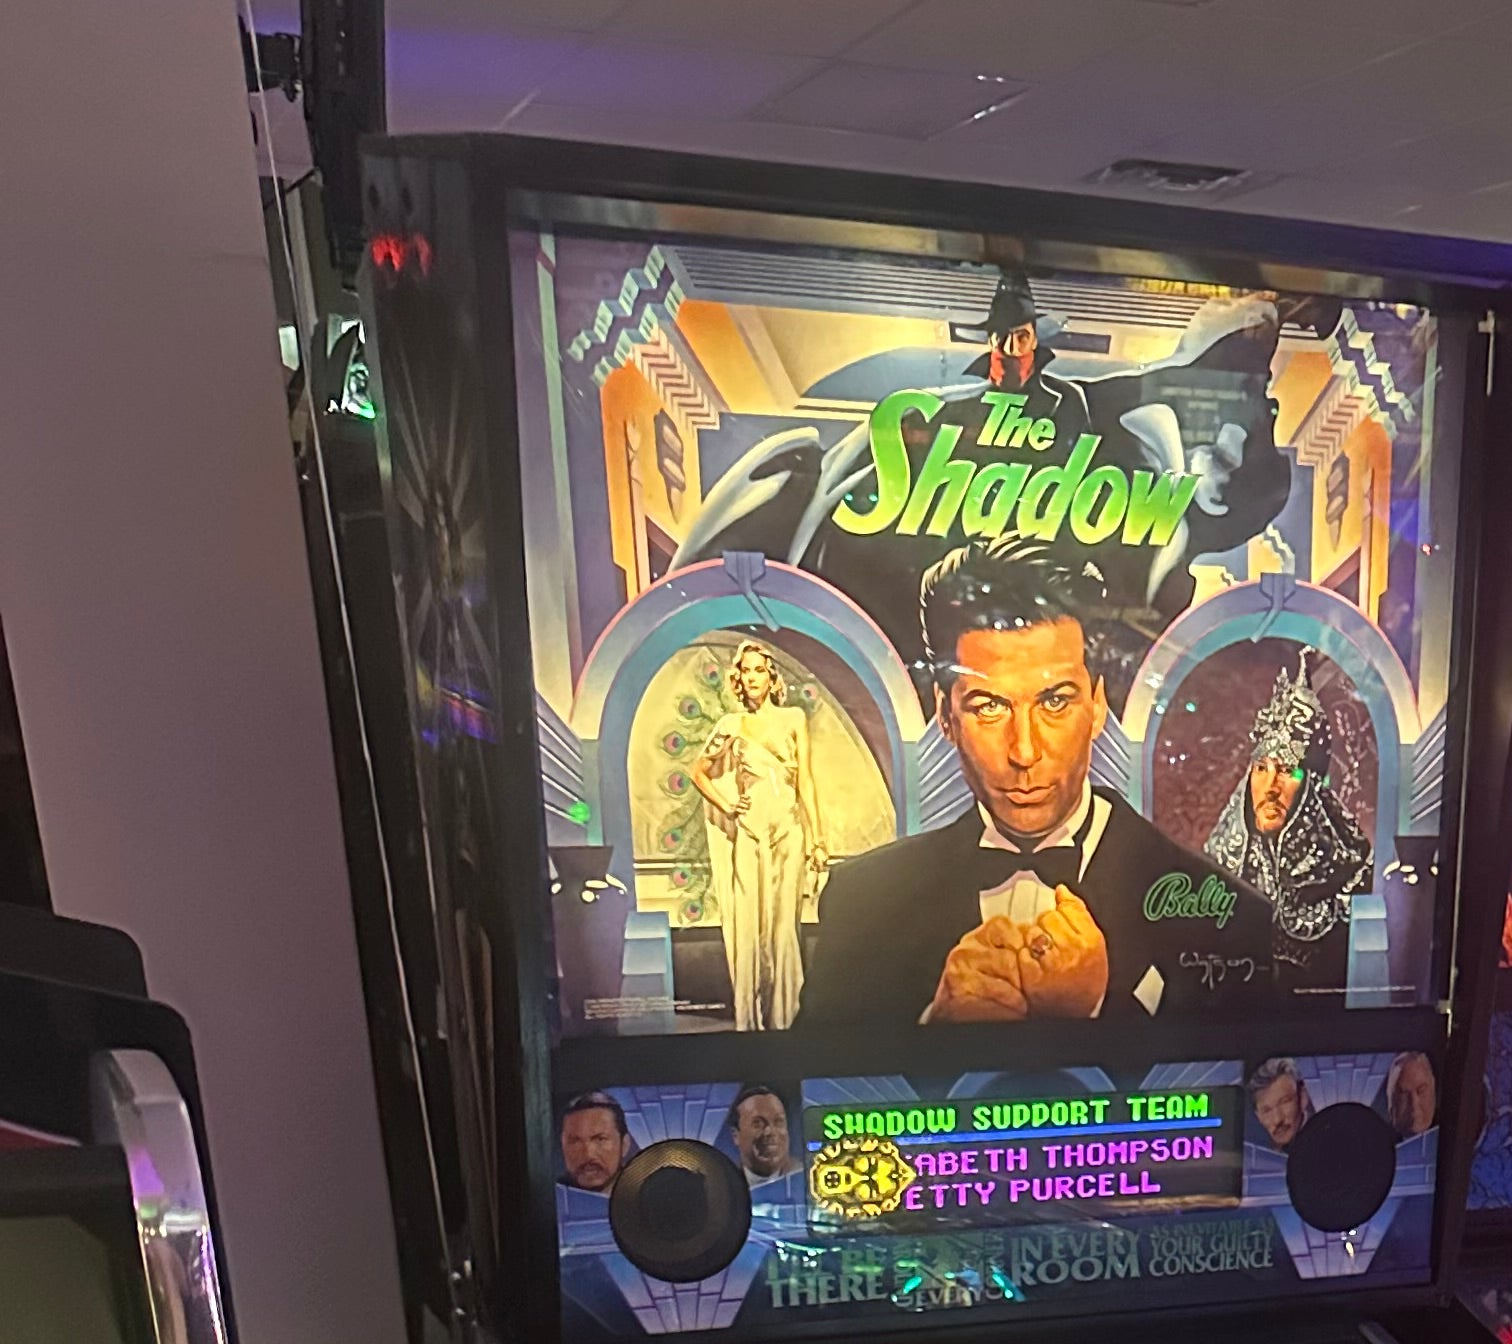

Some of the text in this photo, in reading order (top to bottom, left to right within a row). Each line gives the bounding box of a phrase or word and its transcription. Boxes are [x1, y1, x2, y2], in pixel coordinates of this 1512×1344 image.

[977, 391, 1057, 453] The
[833, 388, 1207, 548] Shadow
[1143, 871, 1238, 930] Bally
[823, 1093, 1209, 1140] SHADOW SUPPORT TEAM
[1041, 1135, 1215, 1170] THOMPSON
[1008, 1170, 1162, 1204] PURCELL
[1047, 1227, 1141, 1259] EVERY
[1149, 1230, 1274, 1259] YOUR GUILTY
[1010, 1254, 1141, 1288] ROOM
[1148, 1250, 1274, 1277] CONSCIENCE
[765, 1269, 887, 1309] THERE
